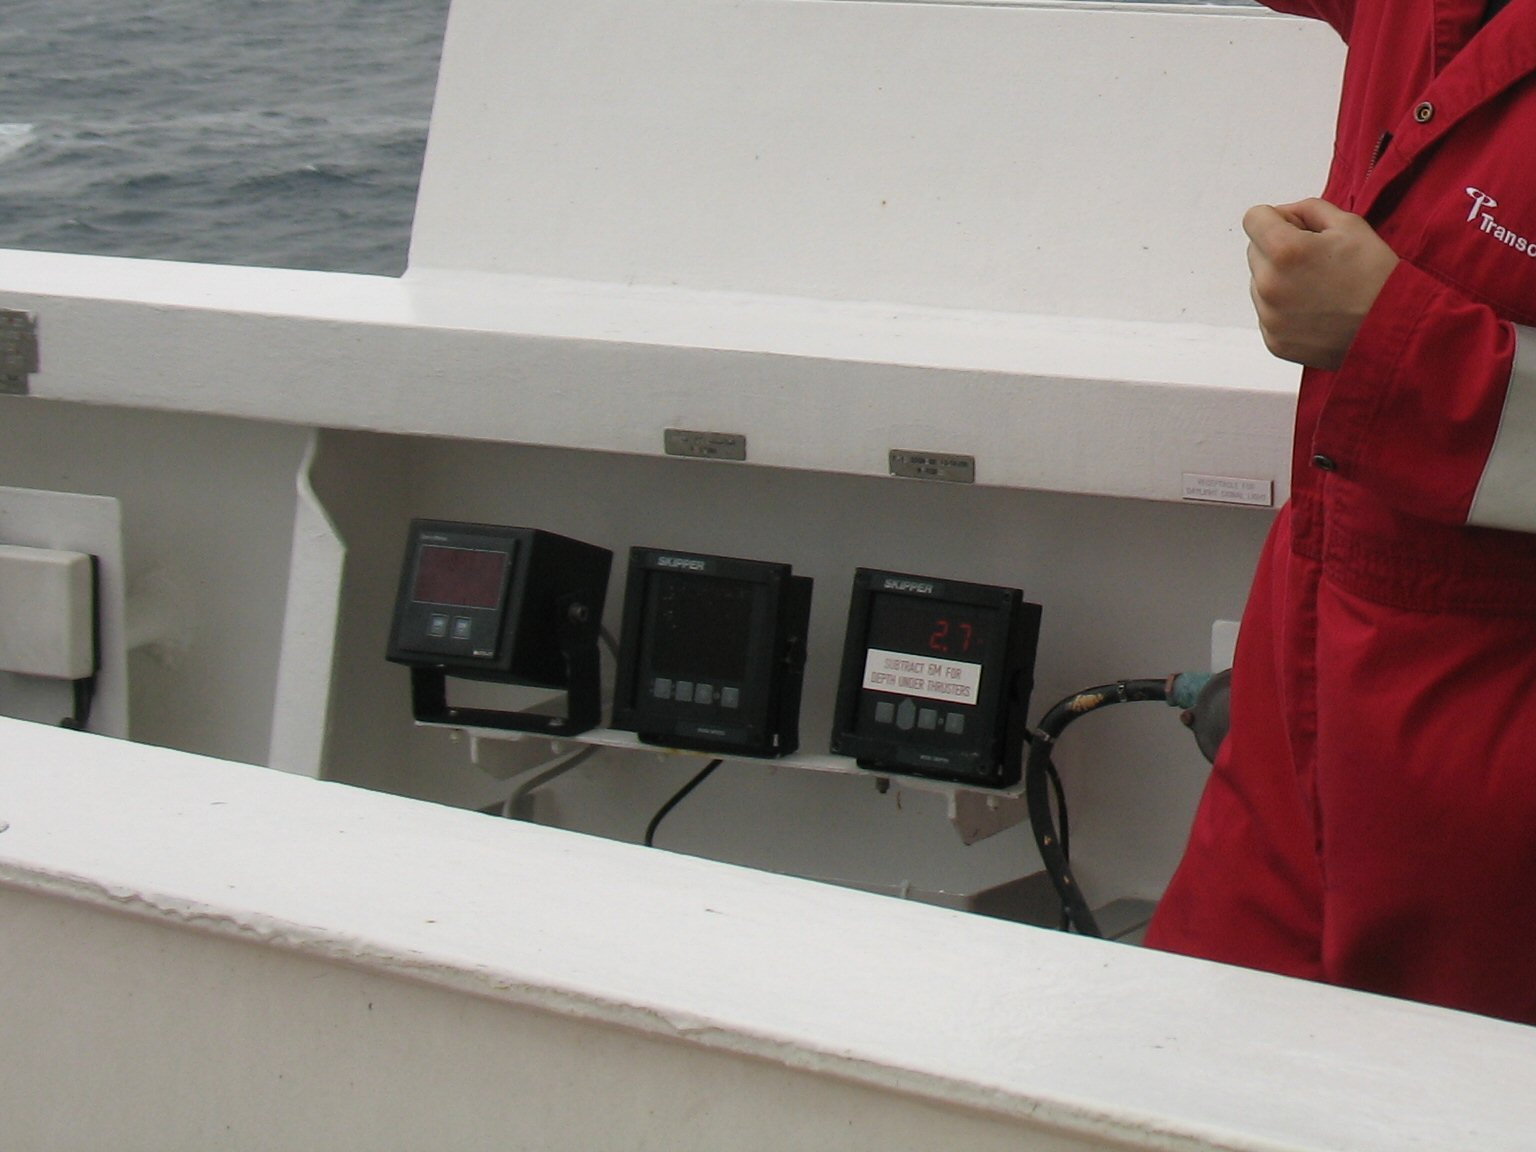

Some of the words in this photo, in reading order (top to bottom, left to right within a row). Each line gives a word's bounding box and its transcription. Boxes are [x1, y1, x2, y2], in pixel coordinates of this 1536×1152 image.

[656, 556, 705, 571] SKIPPER
[883, 579, 934, 594] SKIPPER
[884, 658, 925, 674] SUBTRACT
[945, 667, 962, 679] FOR
[870, 671, 896, 685] DEPTH
[898, 675, 925, 690] UNDER
[927, 679, 972, 697] THRUSTERS
